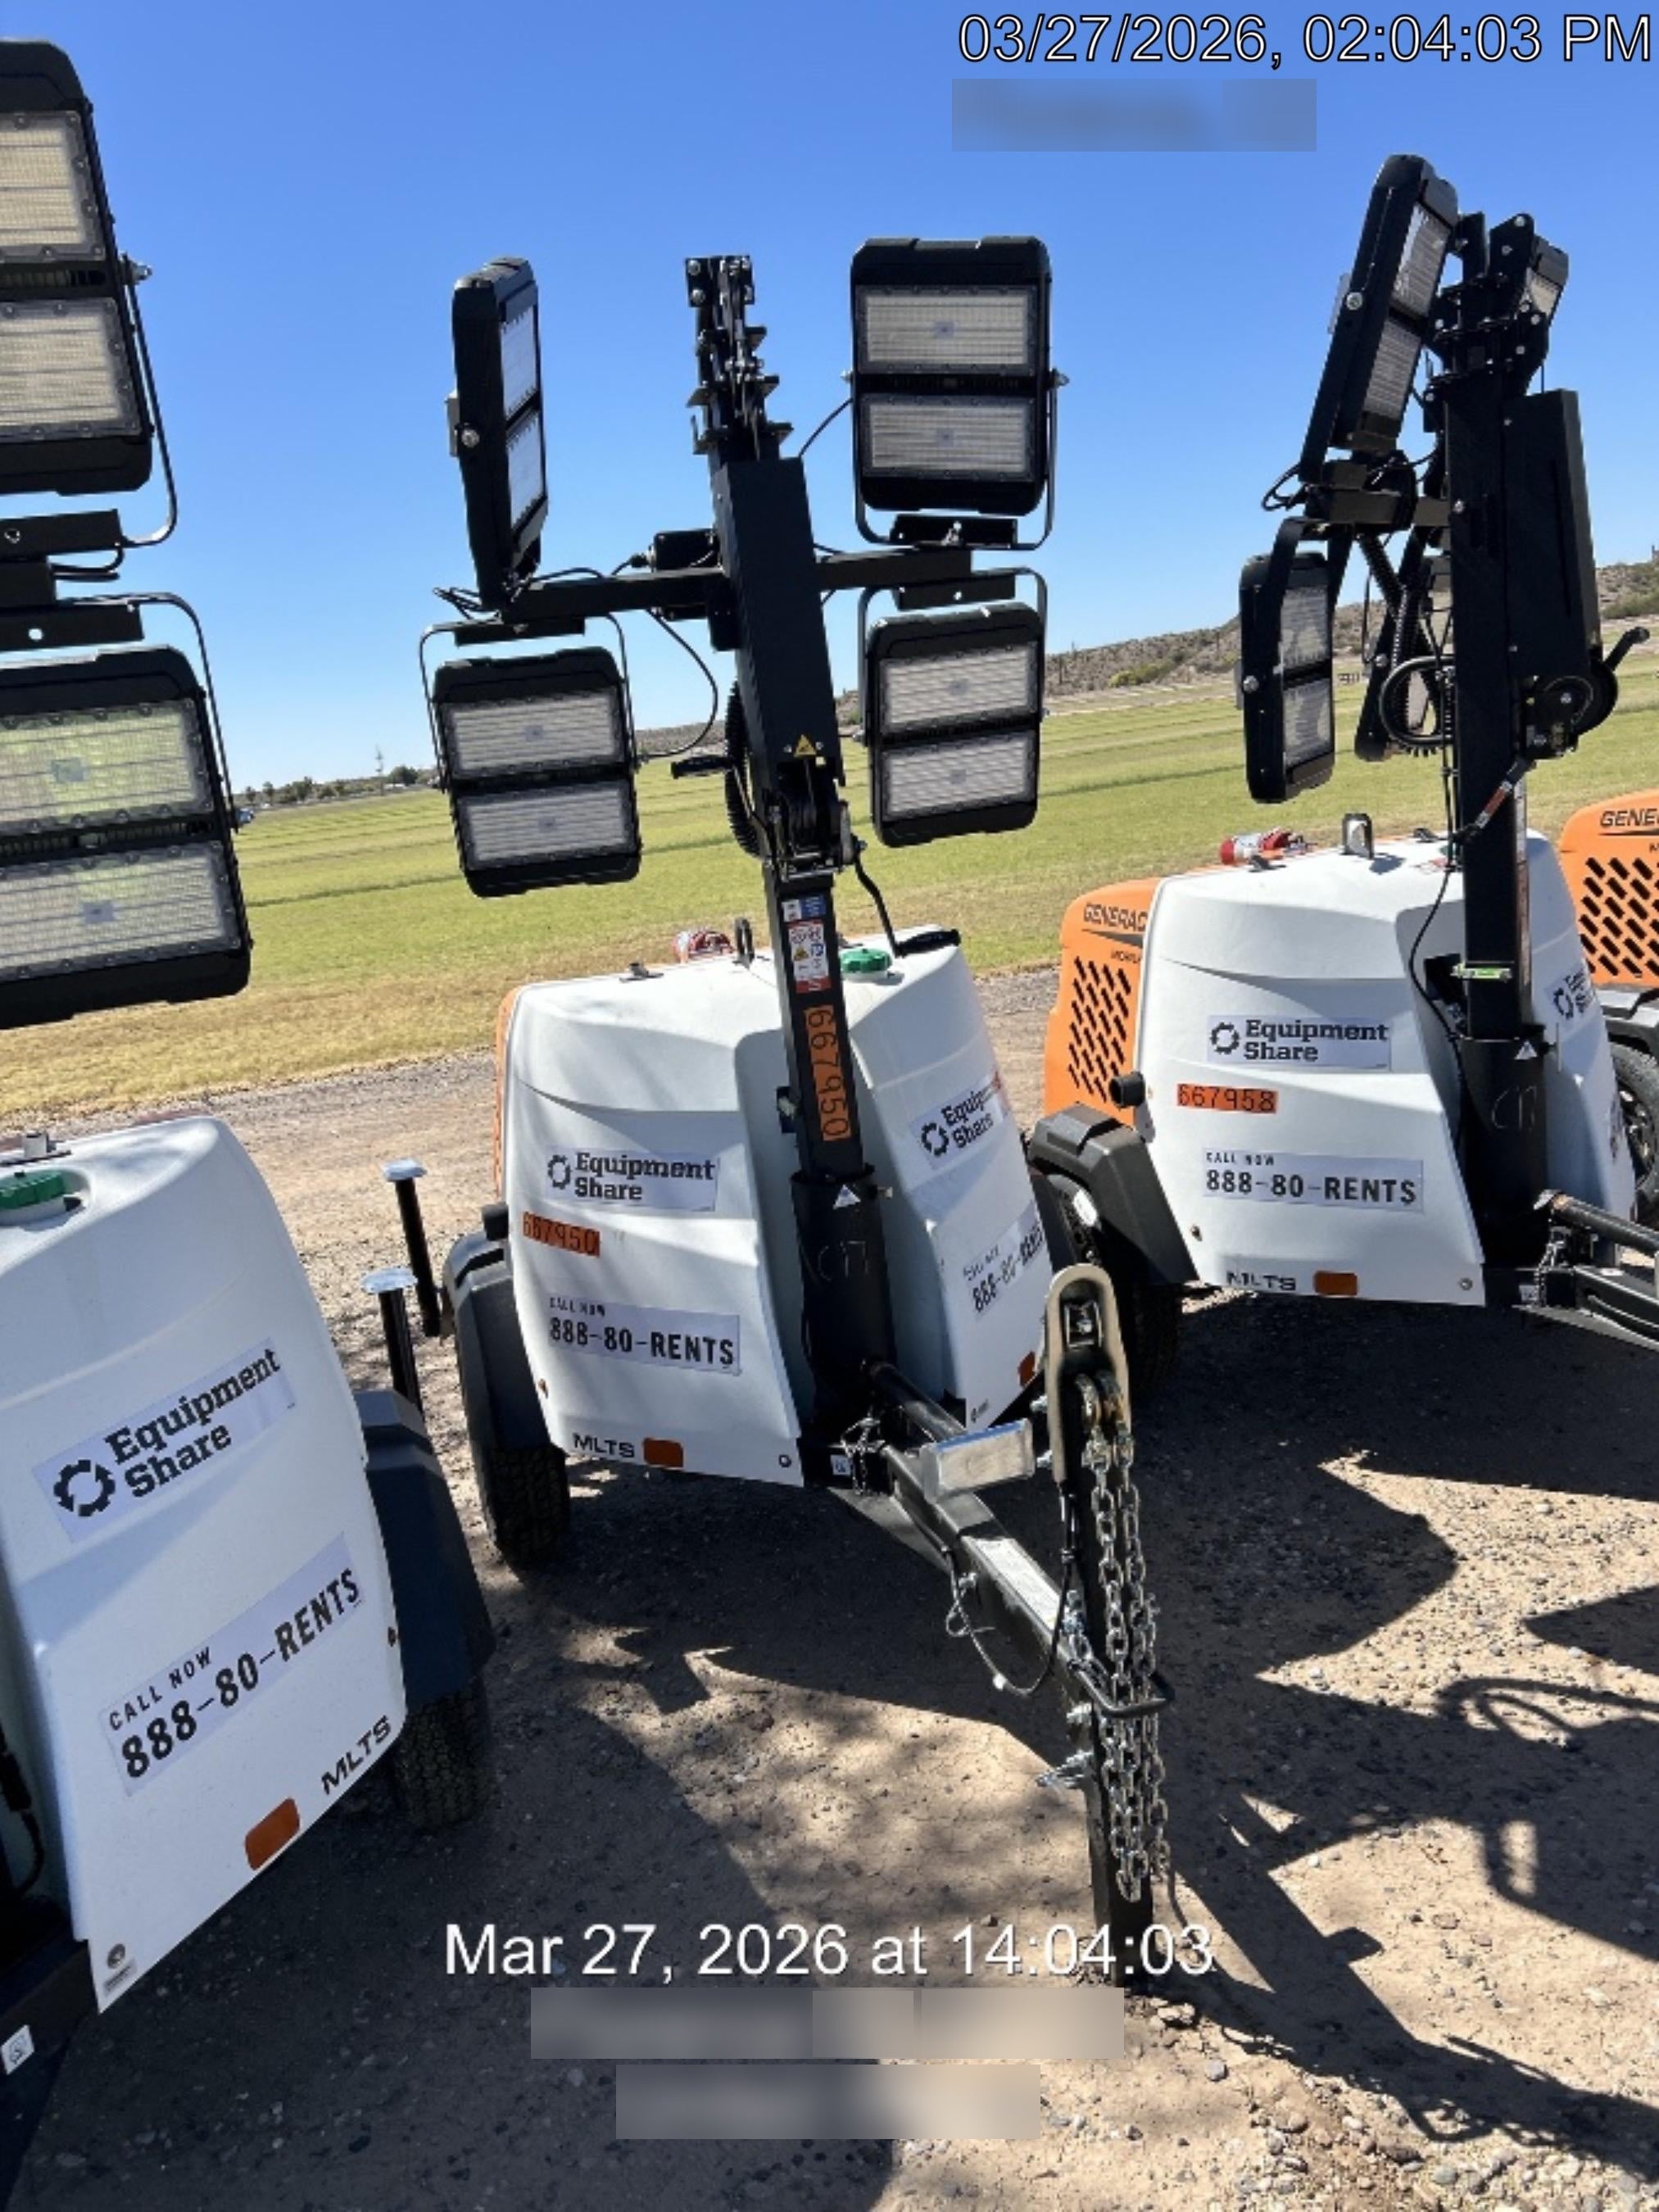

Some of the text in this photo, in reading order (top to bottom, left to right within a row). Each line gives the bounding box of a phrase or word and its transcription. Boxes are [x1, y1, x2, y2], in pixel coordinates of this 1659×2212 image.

[1600, 808, 1659, 828] GENE
[1245, 1019, 1389, 1043] Equipment
[1244, 1041, 1318, 1063] Share
[805, 1009, 850, 1136] 667950
[1176, 1084, 1275, 1112] 667958
[575, 1152, 715, 1181] Equipment
[574, 1176, 642, 1201] Share
[1206, 1169, 1416, 1206] 888-80-RENTS
[550, 1317, 734, 1366] 888-80-RENTS
[104, 1349, 281, 1465] Equipment
[124, 1425, 232, 1498] Share
[573, 1432, 635, 1458] MLTS
[109, 1646, 211, 1731] CALL NOW
[121, 1567, 360, 1779] 888-80-RENTS
[320, 1715, 392, 1795] MLTS
